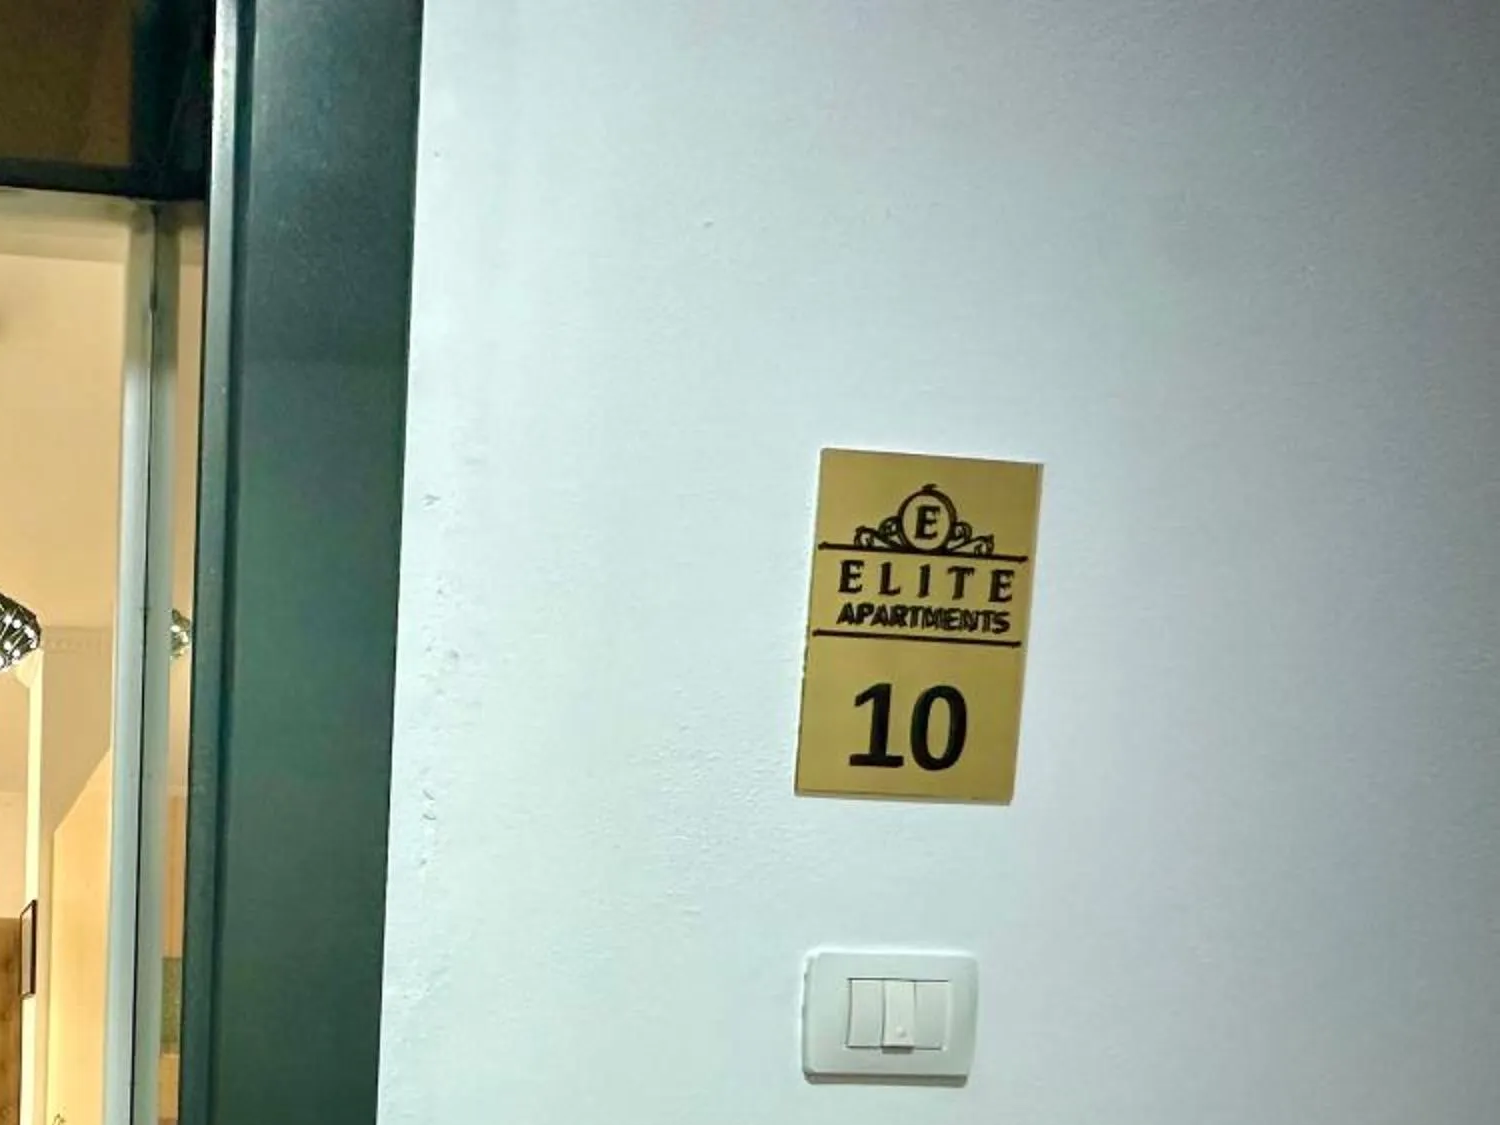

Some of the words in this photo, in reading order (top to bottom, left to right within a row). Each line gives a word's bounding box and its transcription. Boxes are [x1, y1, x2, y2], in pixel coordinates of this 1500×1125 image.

[915, 505, 940, 540] E
[838, 560, 1015, 602] ELITE
[836, 603, 1011, 634] APARTMENTS
[849, 682, 968, 771] 10
